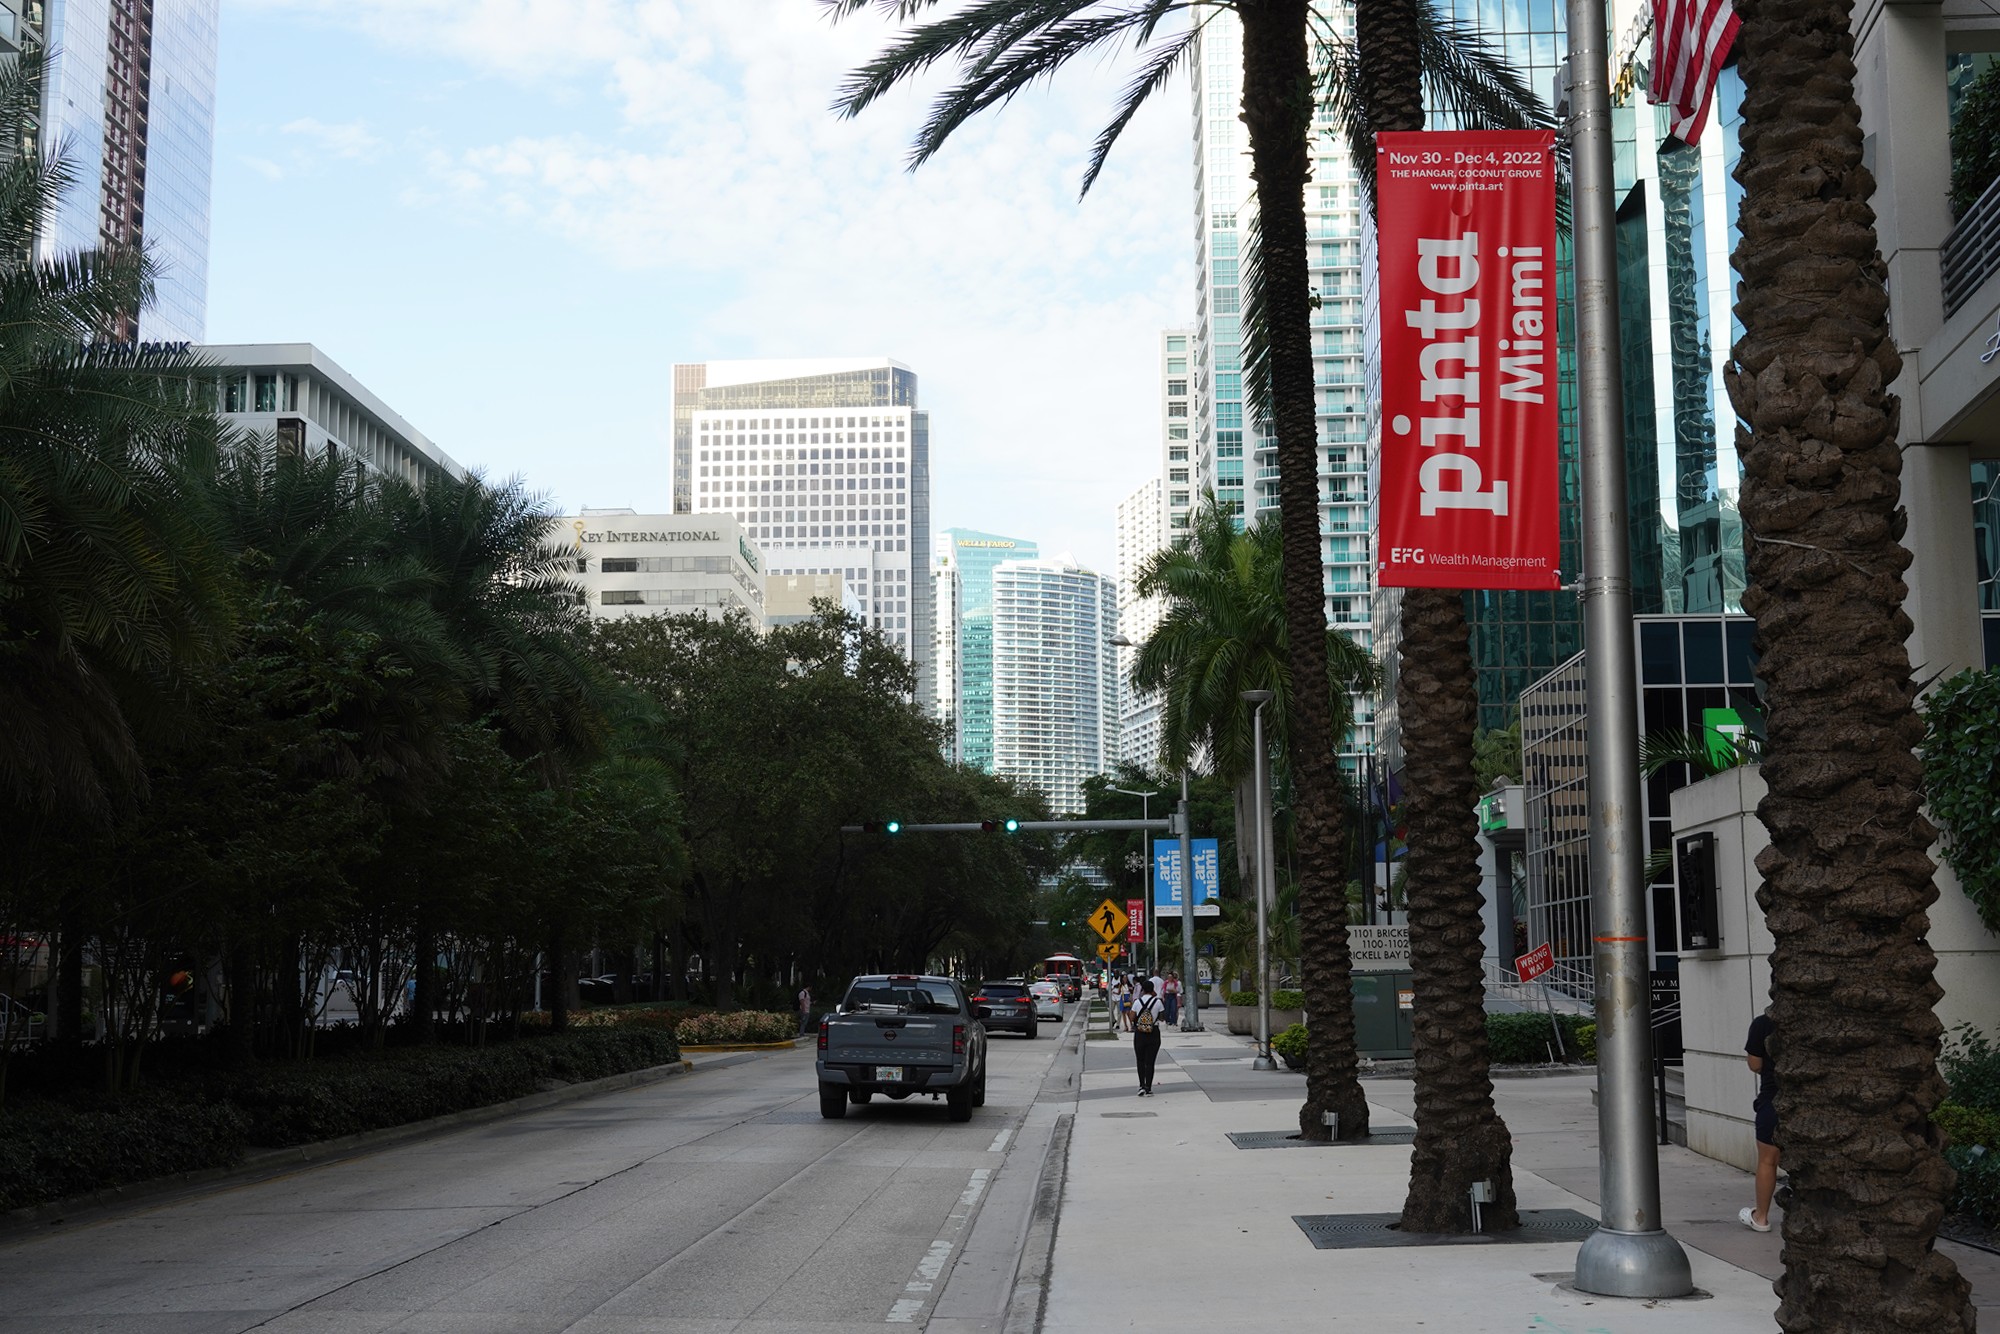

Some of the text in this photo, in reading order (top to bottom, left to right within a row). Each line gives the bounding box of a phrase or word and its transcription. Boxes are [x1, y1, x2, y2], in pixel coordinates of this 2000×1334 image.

[1389, 151, 1417, 165] Nov
[1421, 151, 1442, 165] 30
[1454, 151, 1483, 165] Dec
[1485, 151, 1500, 168] 4,
[1502, 151, 1543, 165] 2022
[1390, 169, 1543, 179] THE HANGAR, COCONUT GROVE
[1430, 182, 1504, 192] www.pinta.art
[1497, 246, 1545, 405] Miami
[140, 341, 191, 356] BANK
[1392, 231, 1509, 517] pinta
[606, 530, 720, 542] INTERNATIONAL
[957, 539, 1016, 549] WELLS FARGO
[1391, 548, 1547, 569] EFG Wealth Management
[1157, 855, 1170, 880] art
[1167, 850, 1182, 901] miami
[1192, 855, 1205, 880] art
[1202, 849, 1217, 899] miami
[1128, 909, 1140, 936] pinta
[1354, 929, 1373, 938] 1101
[1384, 950, 1402, 960] BAY
[1520, 948, 1548, 969] WRONG
[1528, 960, 1545, 976] WAY
